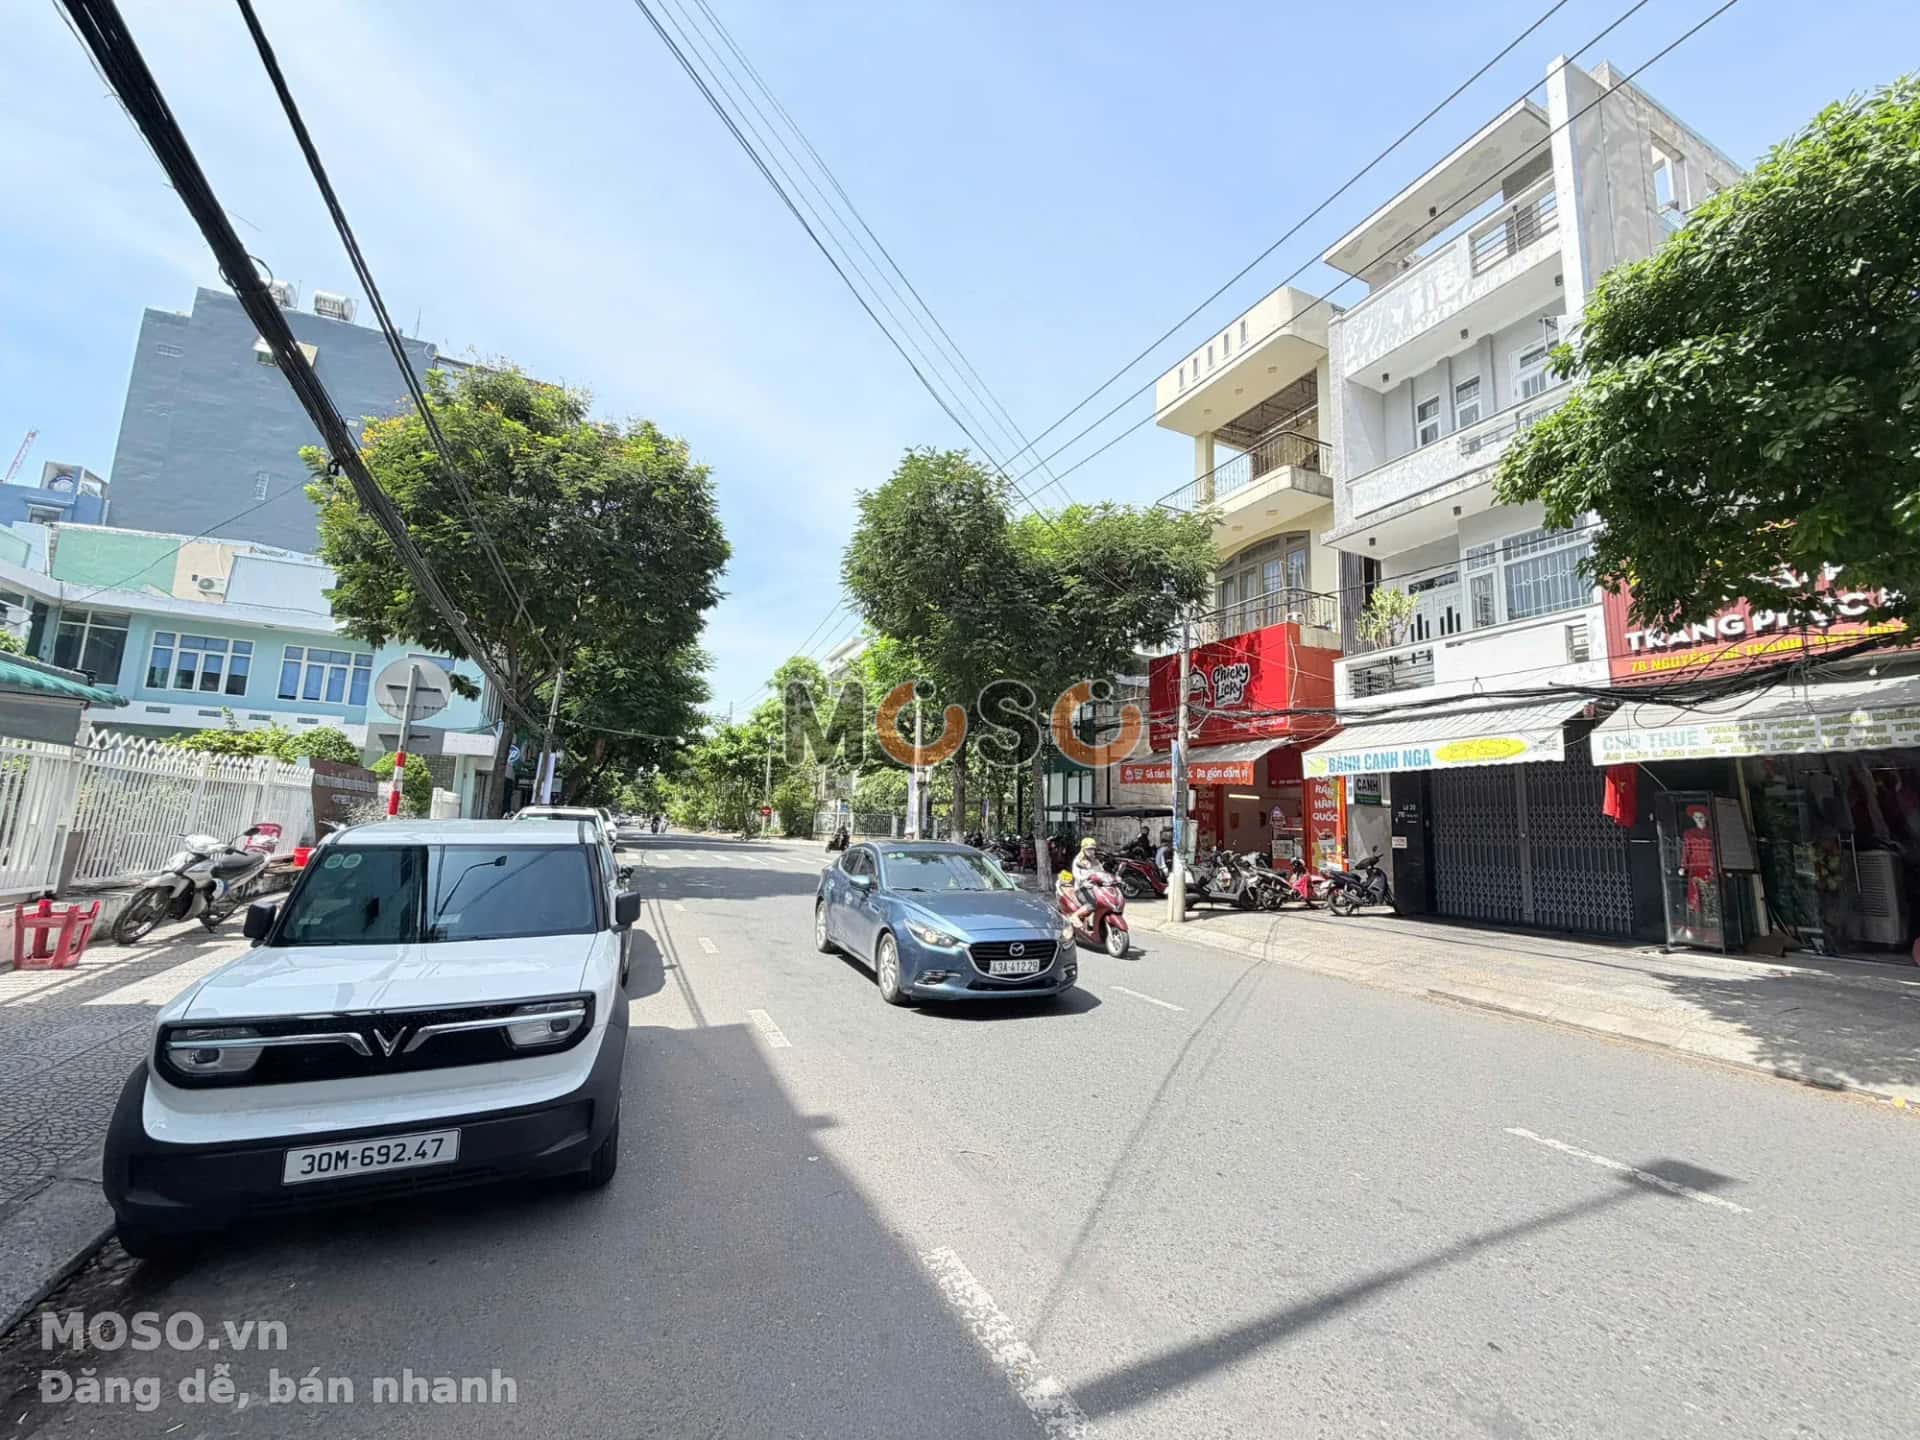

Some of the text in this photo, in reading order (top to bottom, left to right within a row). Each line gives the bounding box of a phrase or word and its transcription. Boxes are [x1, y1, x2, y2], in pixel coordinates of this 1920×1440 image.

[1626, 613, 1745, 651] TRANG
[1364, 751, 1399, 770] CANH
[1403, 748, 1432, 767] NGA
[300, 1138, 444, 1175] 30M-692.47
